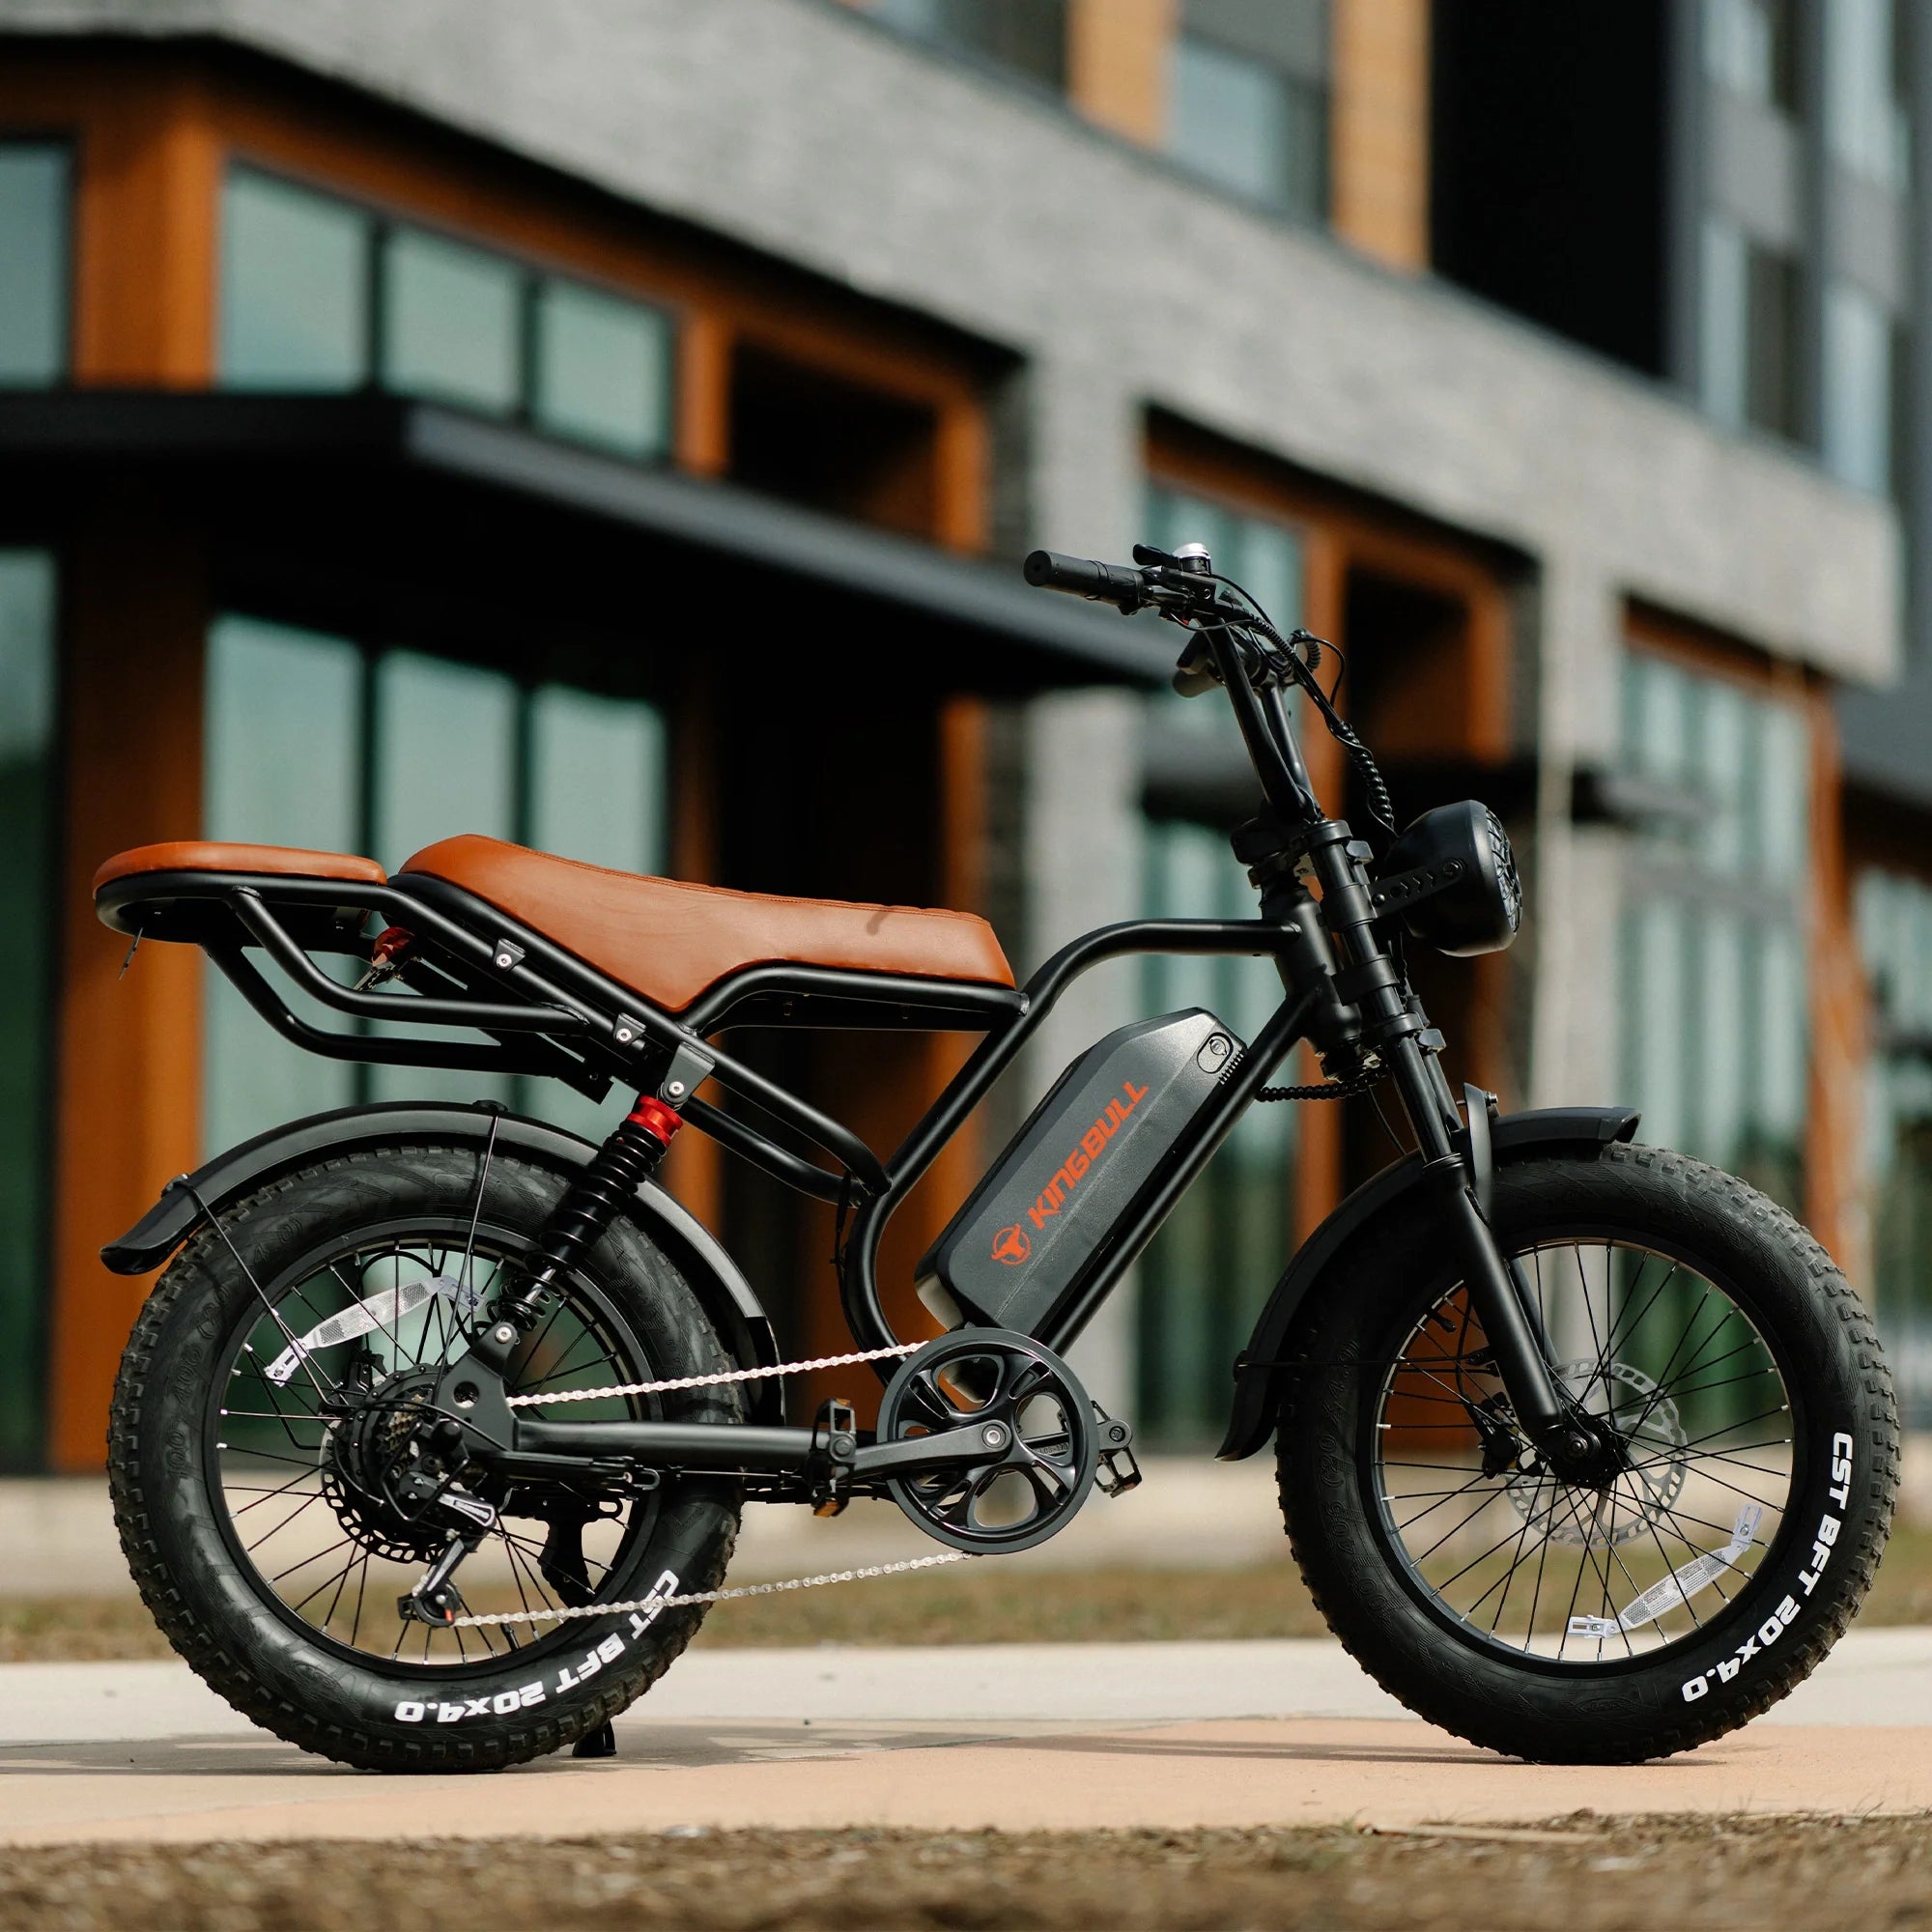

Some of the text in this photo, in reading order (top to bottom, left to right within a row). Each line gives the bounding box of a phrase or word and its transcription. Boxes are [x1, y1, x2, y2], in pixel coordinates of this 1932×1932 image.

[1027, 1081, 1149, 1231] KINGBULL
[1830, 1432, 1853, 1510] CST
[1798, 1514, 1841, 1597] BFT
[555, 1633, 626, 1694] BFT
